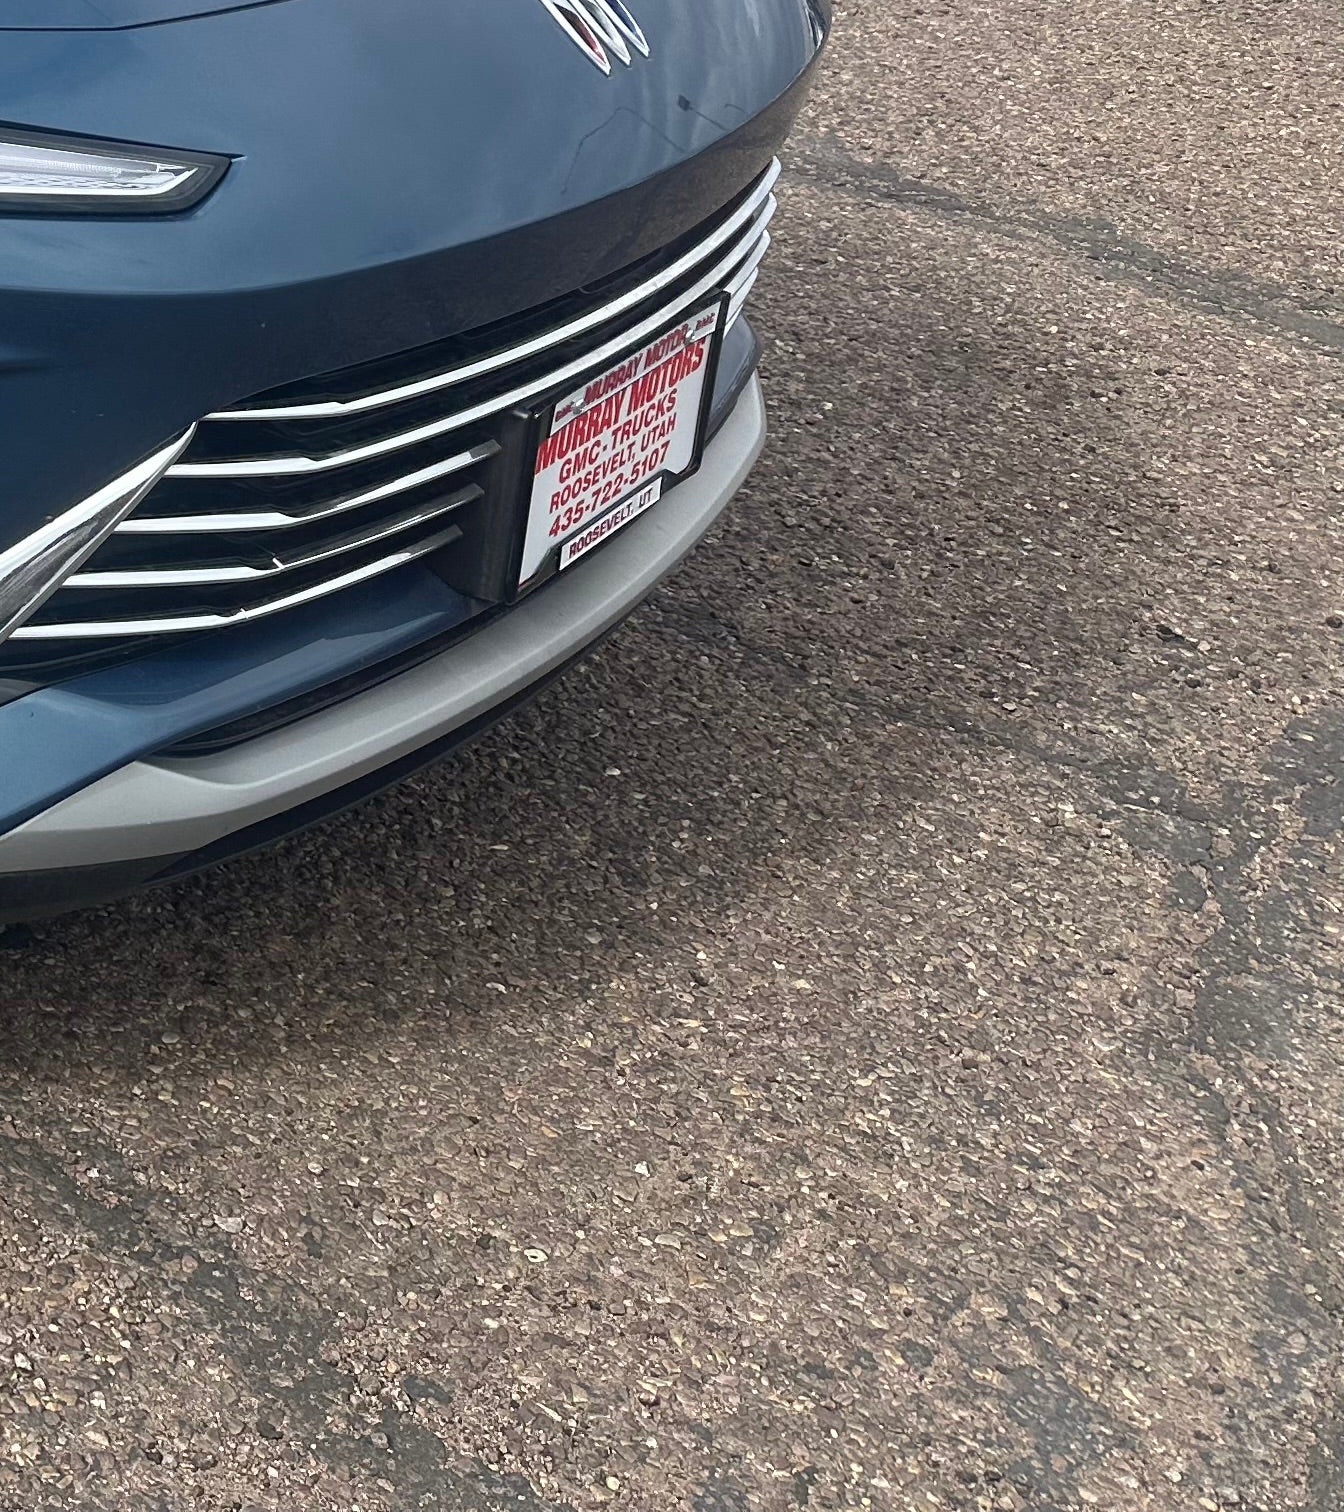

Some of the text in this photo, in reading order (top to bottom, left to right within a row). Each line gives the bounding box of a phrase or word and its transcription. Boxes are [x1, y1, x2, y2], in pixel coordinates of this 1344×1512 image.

[534, 338, 706, 476] MURRAY MOTORS
[583, 353, 644, 404] MURRAY
[549, 412, 677, 514] ROOSEVELT, UTAH
[559, 439, 600, 484] GMC
[612, 388, 678, 444] TRUCKS
[548, 440, 671, 538] 435-722-5107
[638, 487, 653, 508] UT
